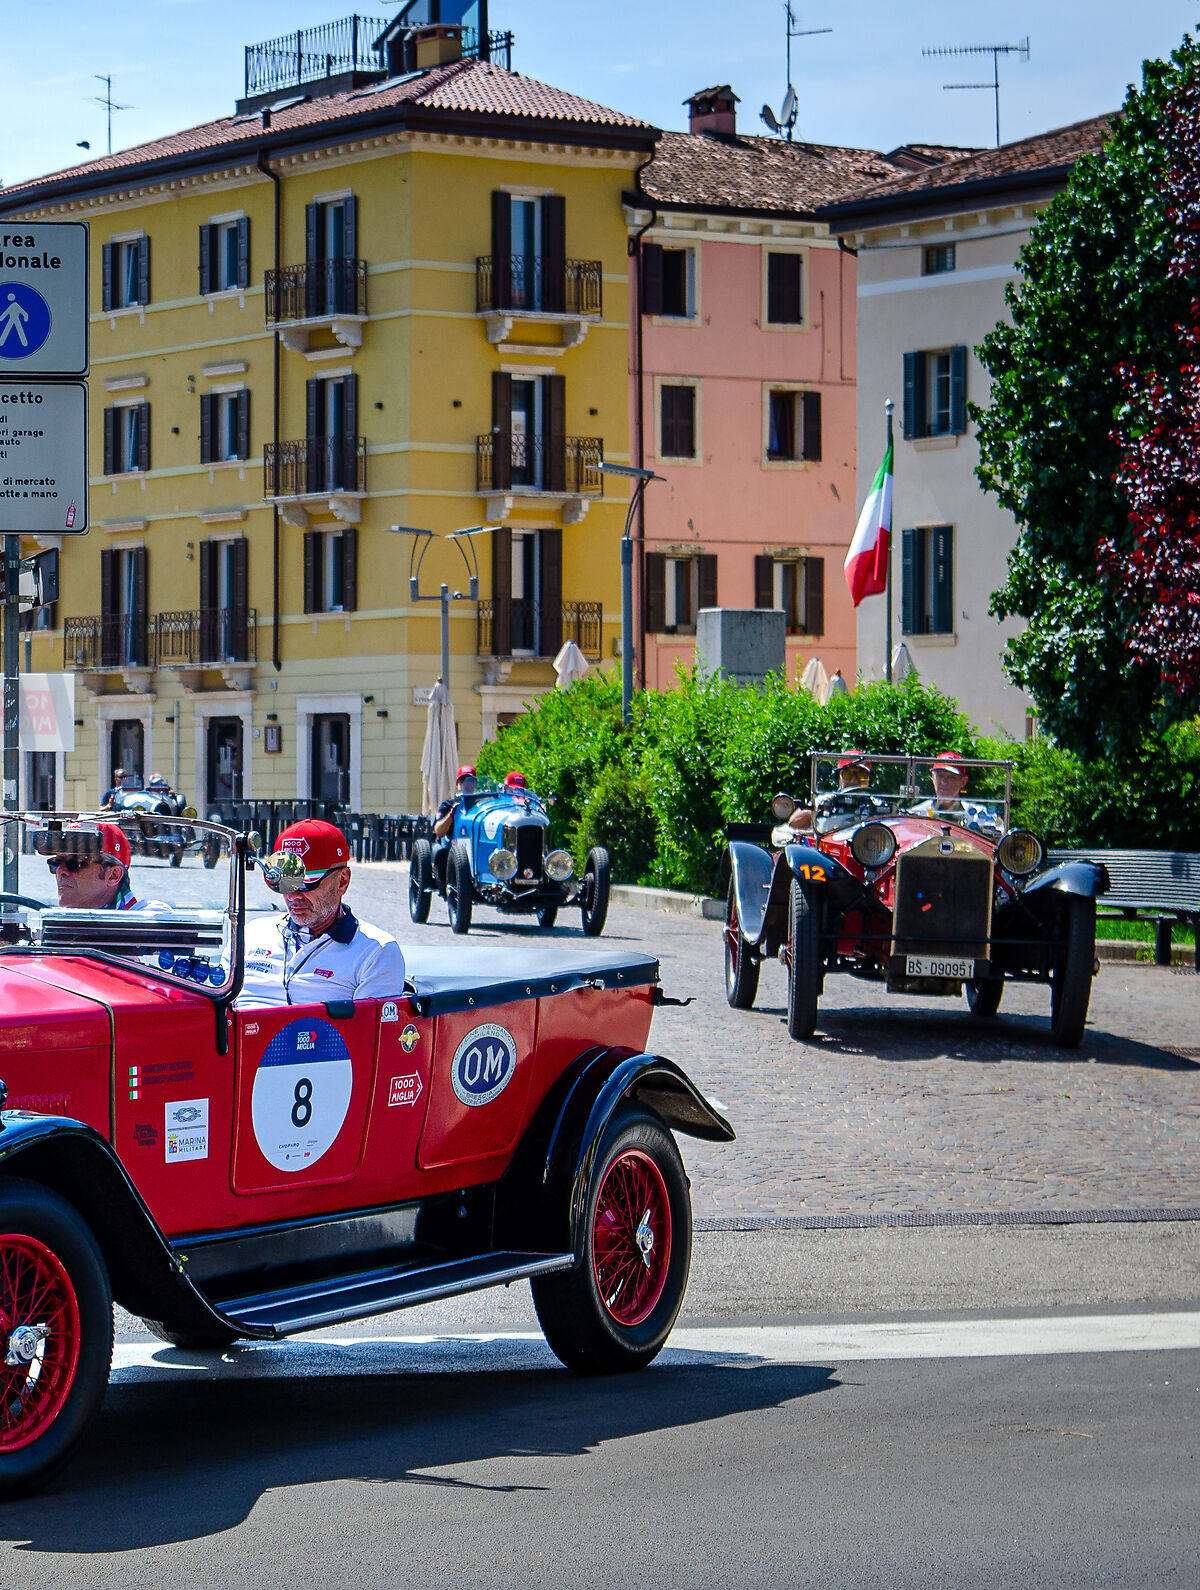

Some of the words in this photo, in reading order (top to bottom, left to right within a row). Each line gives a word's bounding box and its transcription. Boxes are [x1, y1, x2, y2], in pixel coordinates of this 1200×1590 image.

[3, 477, 12, 485] di
[115, 843, 120, 852] 8
[337, 848, 342, 856] 8
[800, 864, 827, 882] 12
[908, 961, 922, 974] BS
[464, 1045, 505, 1086] OM
[395, 1079, 414, 1090] 1000
[392, 1090, 414, 1102] MIGLIA
[291, 1078, 313, 1128] 8
[179, 1136, 206, 1146] MARINA
